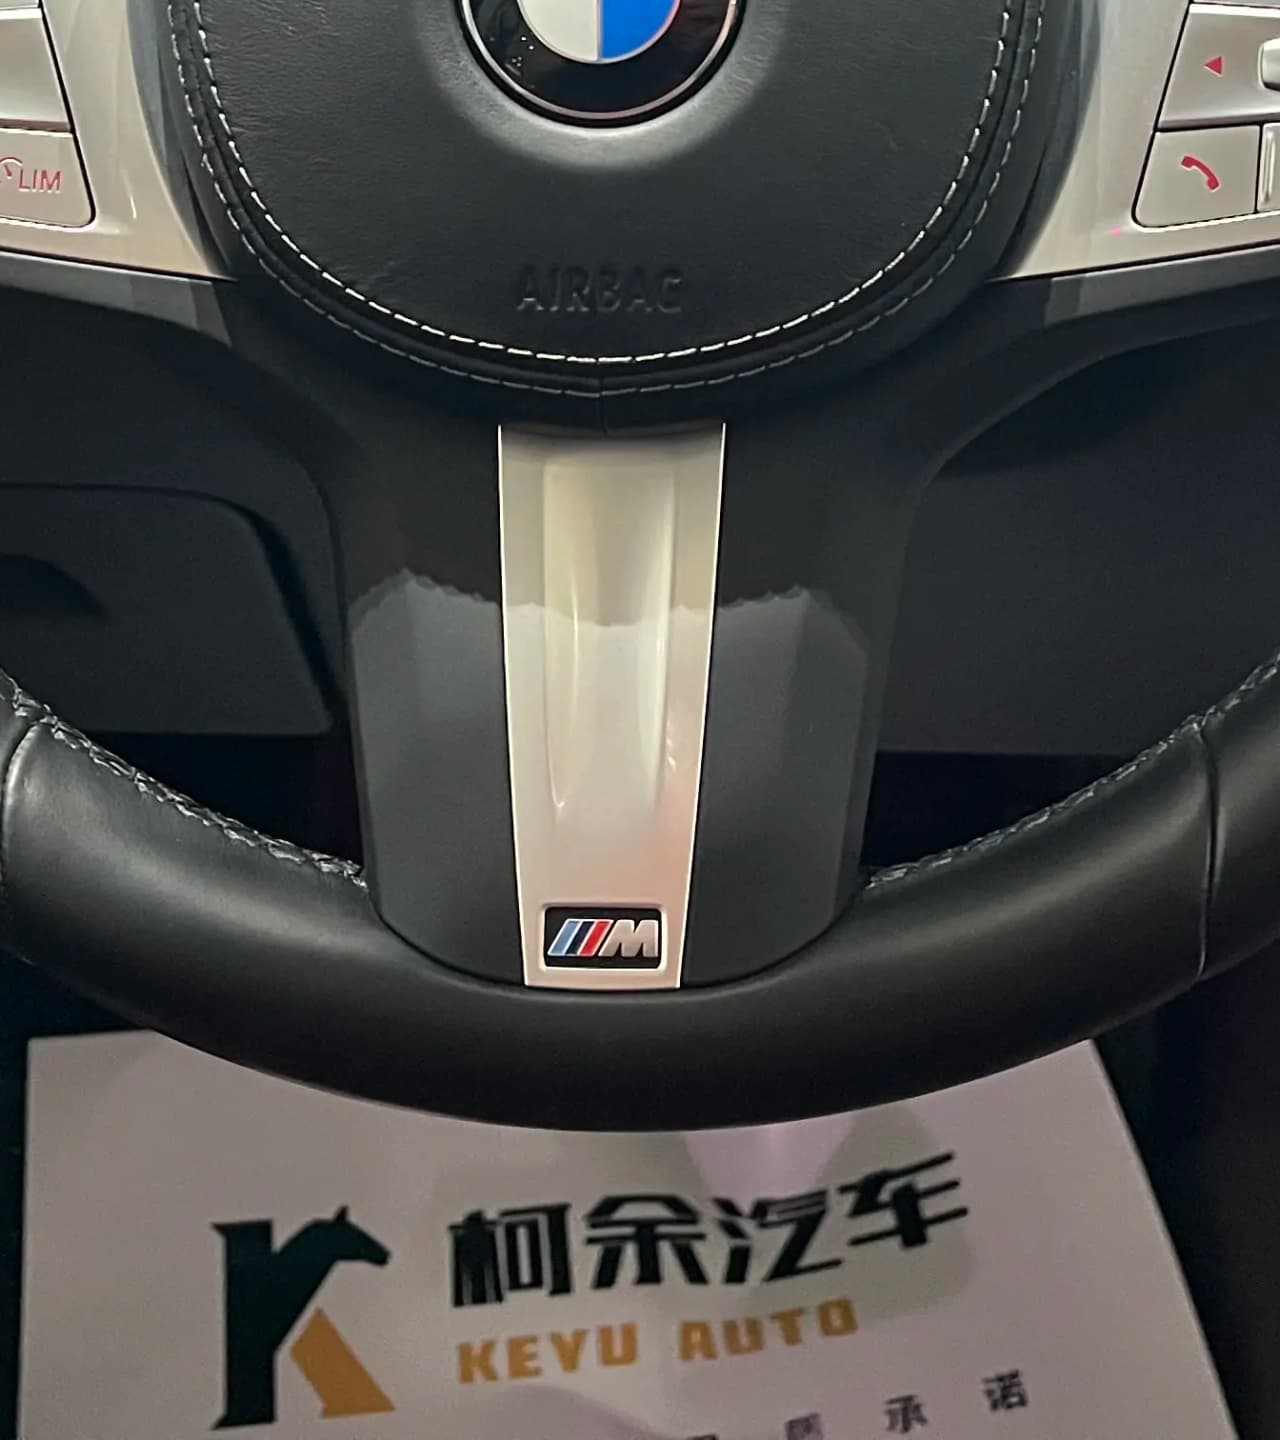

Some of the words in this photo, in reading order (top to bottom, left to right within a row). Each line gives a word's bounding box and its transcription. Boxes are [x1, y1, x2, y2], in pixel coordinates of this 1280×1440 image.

[18, 167, 62, 194] LIM
[448, 1151, 968, 1308] 柯余汽车
[457, 1321, 639, 1384] KEYU
[679, 1297, 860, 1361] AUTO
